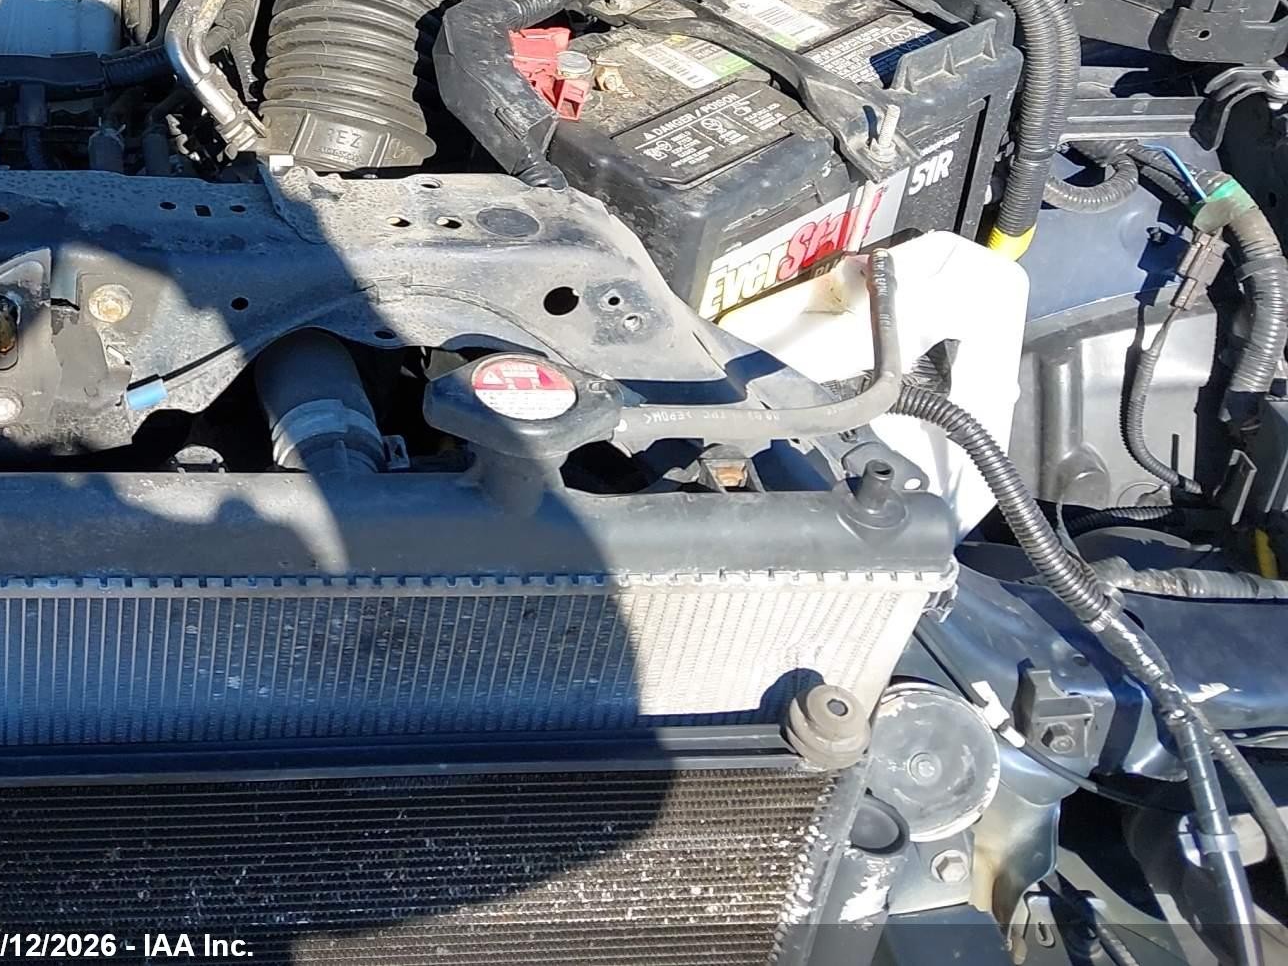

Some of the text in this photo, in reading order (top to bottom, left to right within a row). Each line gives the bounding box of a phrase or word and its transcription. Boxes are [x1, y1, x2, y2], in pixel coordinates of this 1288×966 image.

[652, 113, 697, 136] DANGER
[701, 92, 741, 114] POISON
[908, 149, 955, 196] 51R
